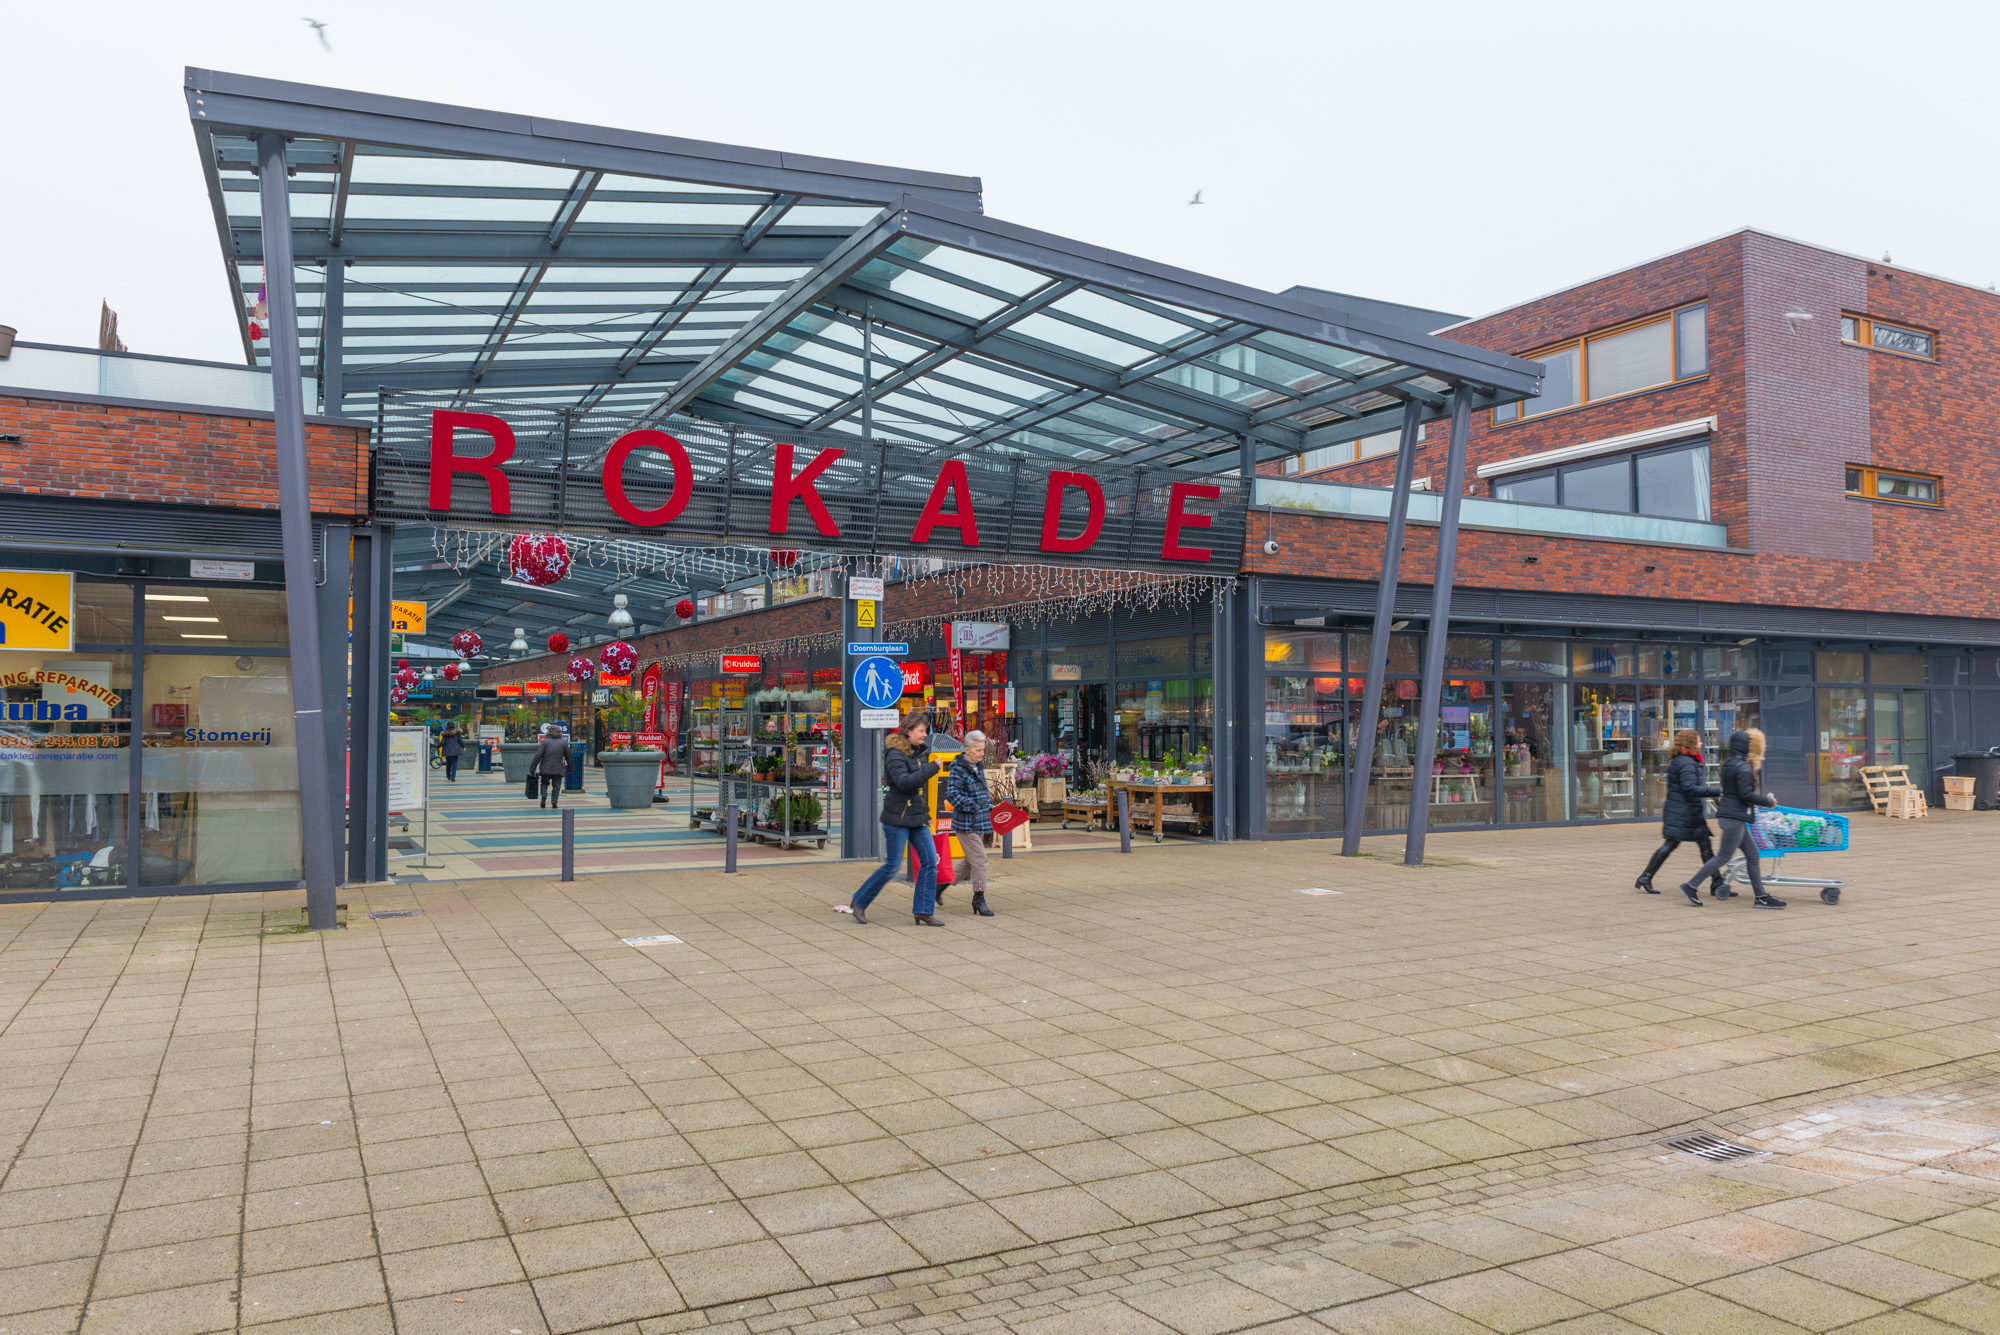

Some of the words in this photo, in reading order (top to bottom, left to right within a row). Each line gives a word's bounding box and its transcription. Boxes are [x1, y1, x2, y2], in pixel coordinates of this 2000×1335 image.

[428, 409, 1221, 561] ROKADE
[963, 629, 974, 641] IRIS
[853, 644, 904, 654] Doornburglaan
[731, 659, 761, 668] Kruidvat
[1519, 660, 1551, 672] KUNST
[903, 669, 920, 685] dvat
[35, 670, 121, 709] REPARATIE
[644, 680, 655, 722] Krudvat
[0, 736, 28, 747] 030
[45, 736, 74, 747] 244
[78, 736, 98, 747] 08
[101, 736, 119, 747] 71
[185, 728, 271, 746] Stomerij
